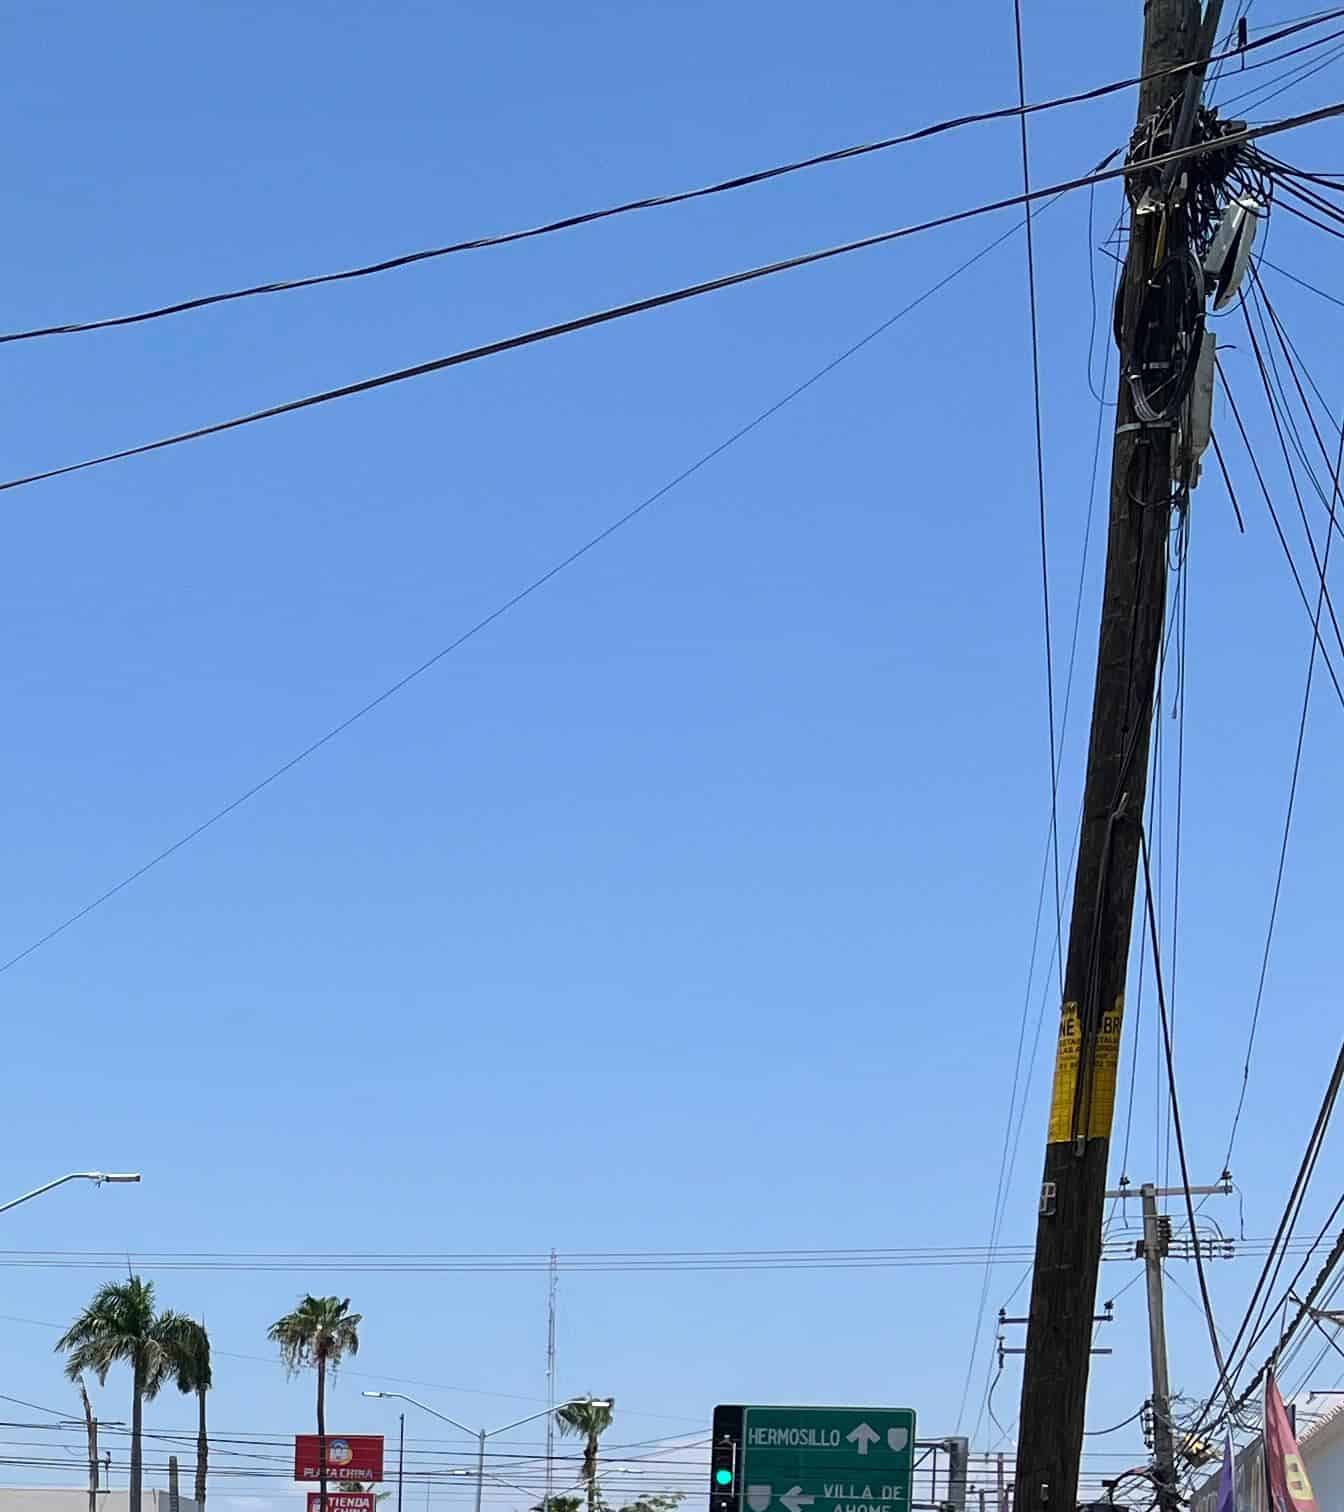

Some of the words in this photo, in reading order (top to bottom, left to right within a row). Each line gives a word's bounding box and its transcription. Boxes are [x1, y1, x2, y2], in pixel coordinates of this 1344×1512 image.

[748, 1427, 841, 1447] HERMOSILLO
[823, 1483, 873, 1499] VILLA
[881, 1485, 905, 1500] DE
[328, 1497, 370, 1508] TIENDA
